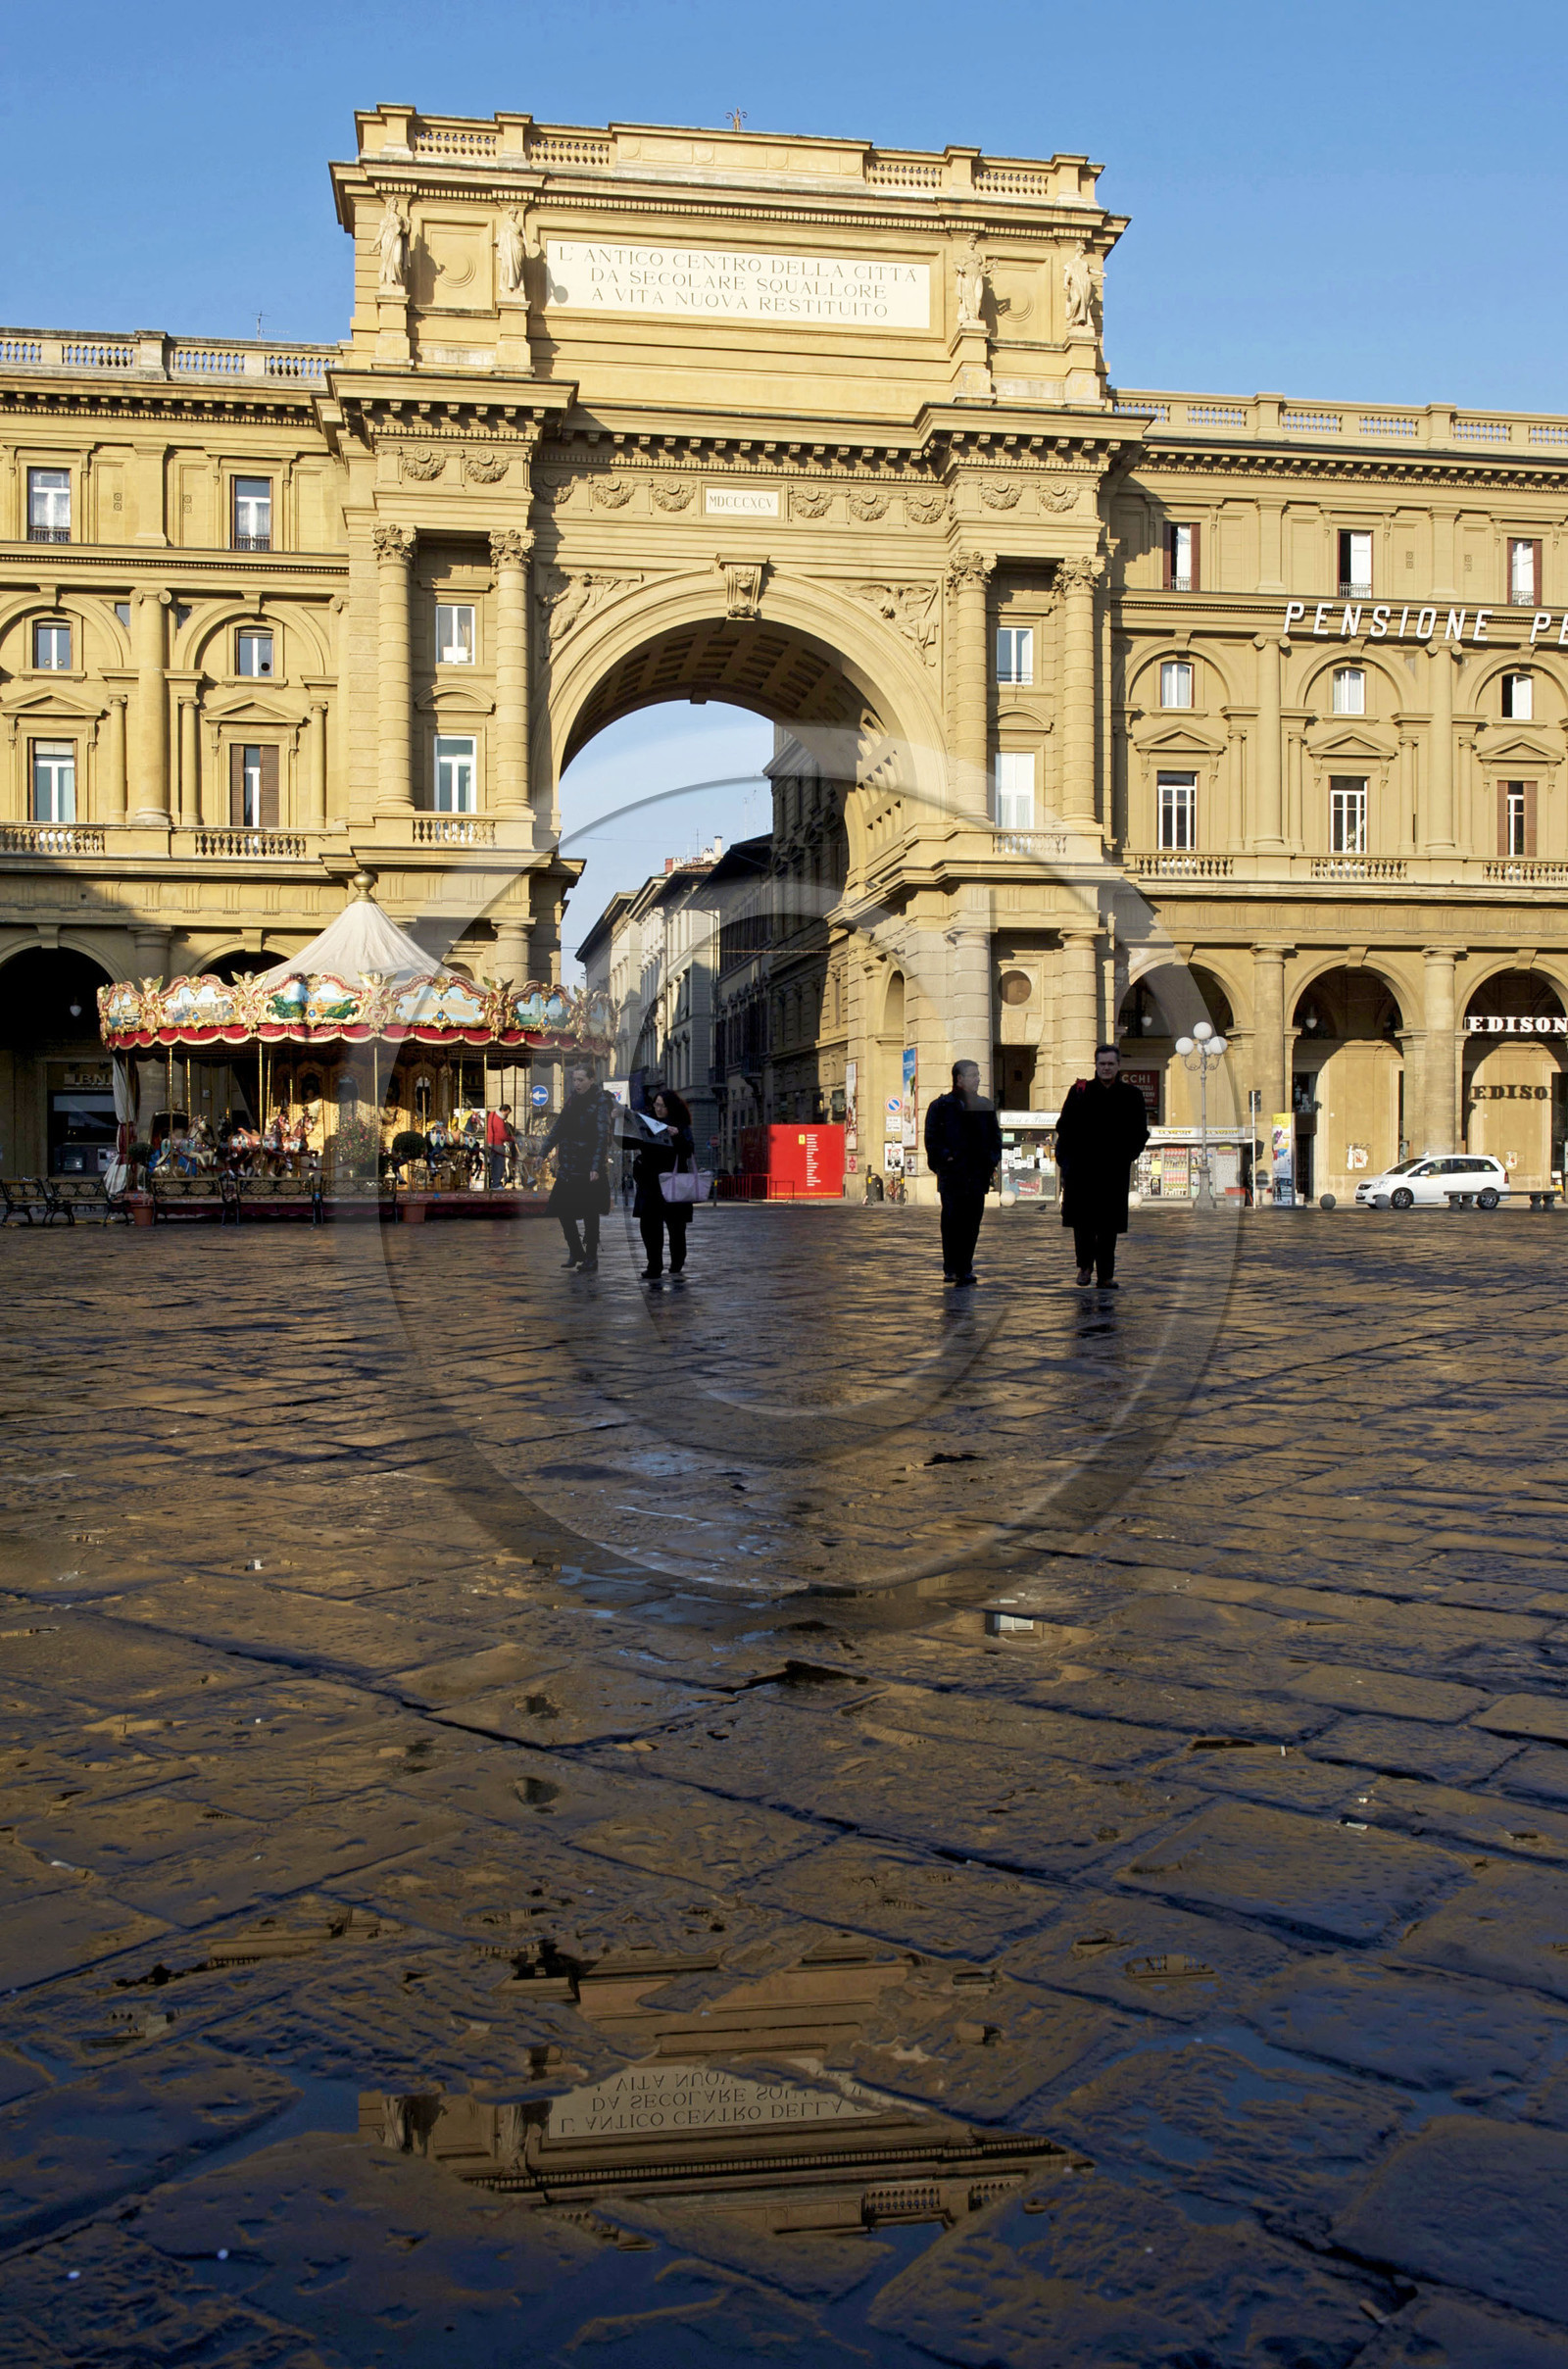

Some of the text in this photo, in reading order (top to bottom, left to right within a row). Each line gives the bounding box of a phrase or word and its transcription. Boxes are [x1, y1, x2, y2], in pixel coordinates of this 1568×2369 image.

[584, 248, 663, 268] ANTICO
[673, 254, 761, 272] CENTRO
[772, 260, 844, 278] DELLA
[591, 267, 887, 300] DA SECOLARE SQUALLORE
[592, 288, 888, 318] A VITA NUOVA RESTITUITO
[709, 495, 773, 509] MDCCCXCV
[1284, 602, 1494, 641] PENSIONE
[1468, 1015, 1568, 1033] EDISON
[1121, 1073, 1152, 1084] CCHI
[1472, 1084, 1548, 1100] EDISO
